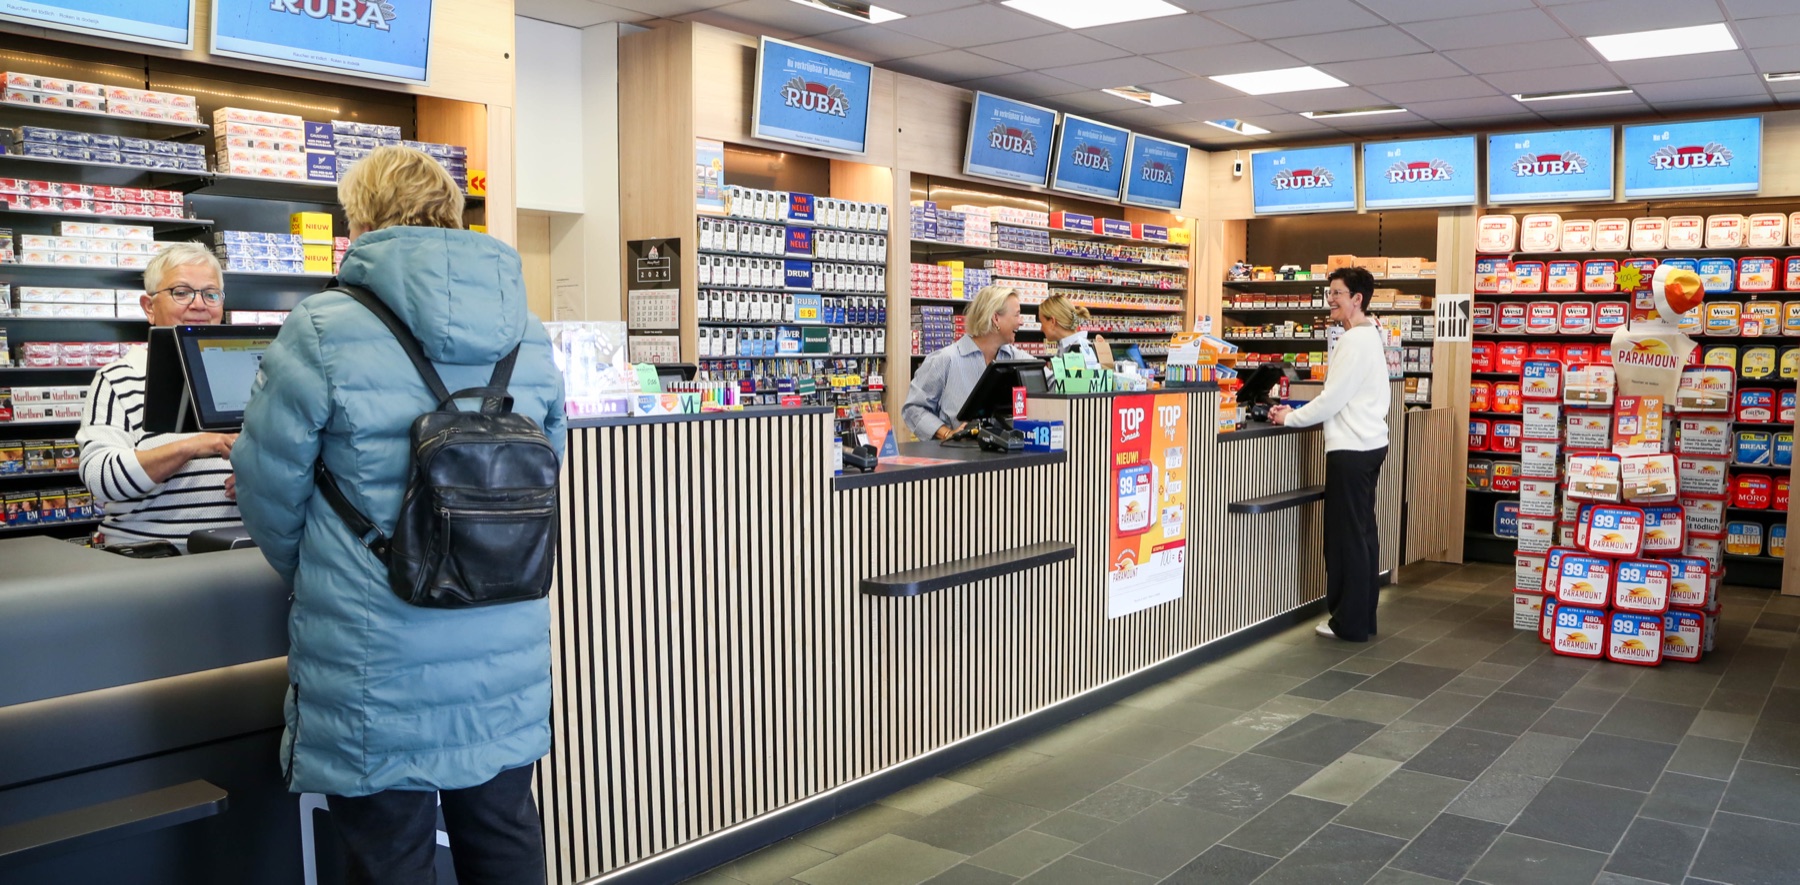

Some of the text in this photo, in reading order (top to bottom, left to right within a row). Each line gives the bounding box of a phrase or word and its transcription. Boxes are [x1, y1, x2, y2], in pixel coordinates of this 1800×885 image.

[6, 4, 30, 13] Rauchen
[59, 12, 75, 20] Roken
[794, 60, 823, 74] verkrijgbaar
[785, 87, 846, 117] RUBA
[991, 132, 1034, 155] RUBA
[1074, 151, 1110, 171] RUBA
[1654, 152, 1729, 170] RUBA
[1517, 160, 1584, 177] RUBA
[1142, 167, 1172, 184] RUBA
[1390, 168, 1451, 183] RUBA
[1276, 175, 1331, 190] RUBA
[794, 195, 807, 203] VAN
[792, 204, 810, 212] NELLE
[306, 223, 329, 231] NIEUW
[790, 240, 809, 249] NELLE
[787, 270, 810, 278] DRUM
[1618, 350, 1679, 369] PARAMOUN
[1709, 351, 1732, 359] CAMEL
[1747, 351, 1770, 359] CAMEL
[1502, 357, 1521, 365] Winston
[14, 388, 40, 401] Marlboro
[52, 388, 78, 401] Marlboro
[1620, 399, 1635, 407] TOP
[16, 408, 43, 419] Marlboro
[55, 407, 82, 418] Marlboro
[1158, 405, 1181, 427] TOP
[1119, 407, 1145, 431] TOP
[1033, 426, 1049, 445] 18
[1116, 451, 1139, 465] NIEUW!
[1739, 494, 1766, 502] MORO
[1121, 510, 1146, 523] PARAMOUNT
[1692, 523, 1720, 531] tödlich
[1728, 534, 1760, 544] DENIM
[1593, 540, 1633, 550] PARAMOUNT
[1590, 565, 1606, 573] 480g
[1647, 570, 1665, 578] 480g
[1686, 565, 1703, 573] 480g
[1113, 568, 1138, 582] PARAMOUNT
[1563, 589, 1602, 600] PARAMOUNT
[1620, 594, 1661, 606] PARAMOUNT
[1584, 615, 1601, 623] 480g
[1681, 618, 1698, 627] 480g
[1640, 622, 1658, 631] 480g
[1559, 639, 1598, 650] PARAMOUNT
[1614, 646, 1655, 657] PARAMOUNT
